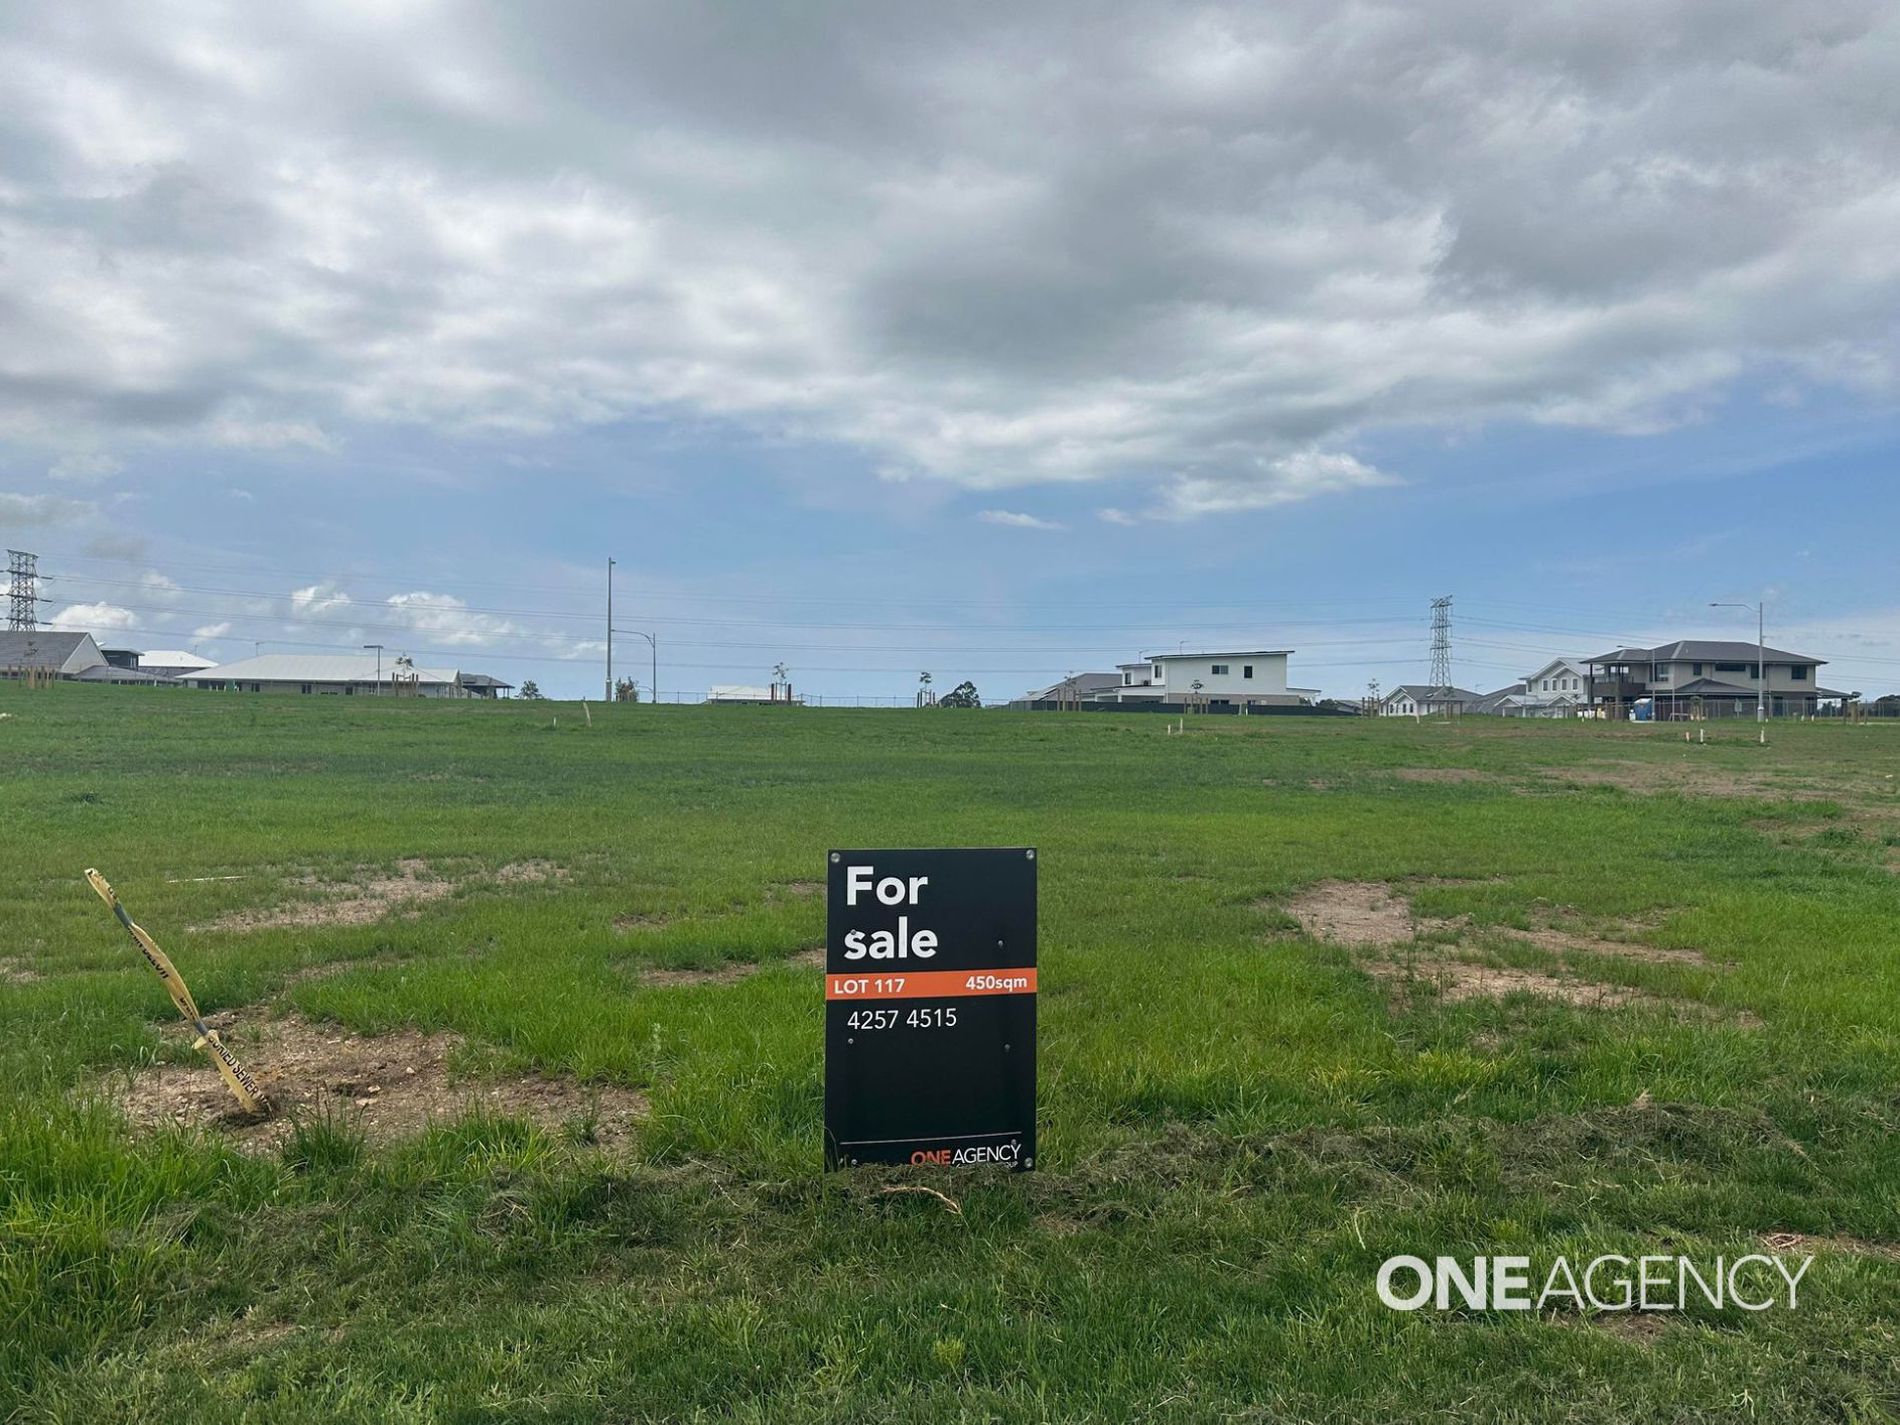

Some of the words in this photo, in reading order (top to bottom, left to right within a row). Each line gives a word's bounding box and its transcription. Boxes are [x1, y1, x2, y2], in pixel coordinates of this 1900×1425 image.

[847, 865, 928, 905] For
[844, 916, 938, 960] sale
[834, 979, 869, 994] LOT
[874, 978, 905, 993] 117
[965, 976, 1028, 992] 450sqm
[847, 1010, 898, 1030] 4257
[906, 1008, 957, 1028] 4515
[232, 1063, 259, 1098] SEWER
